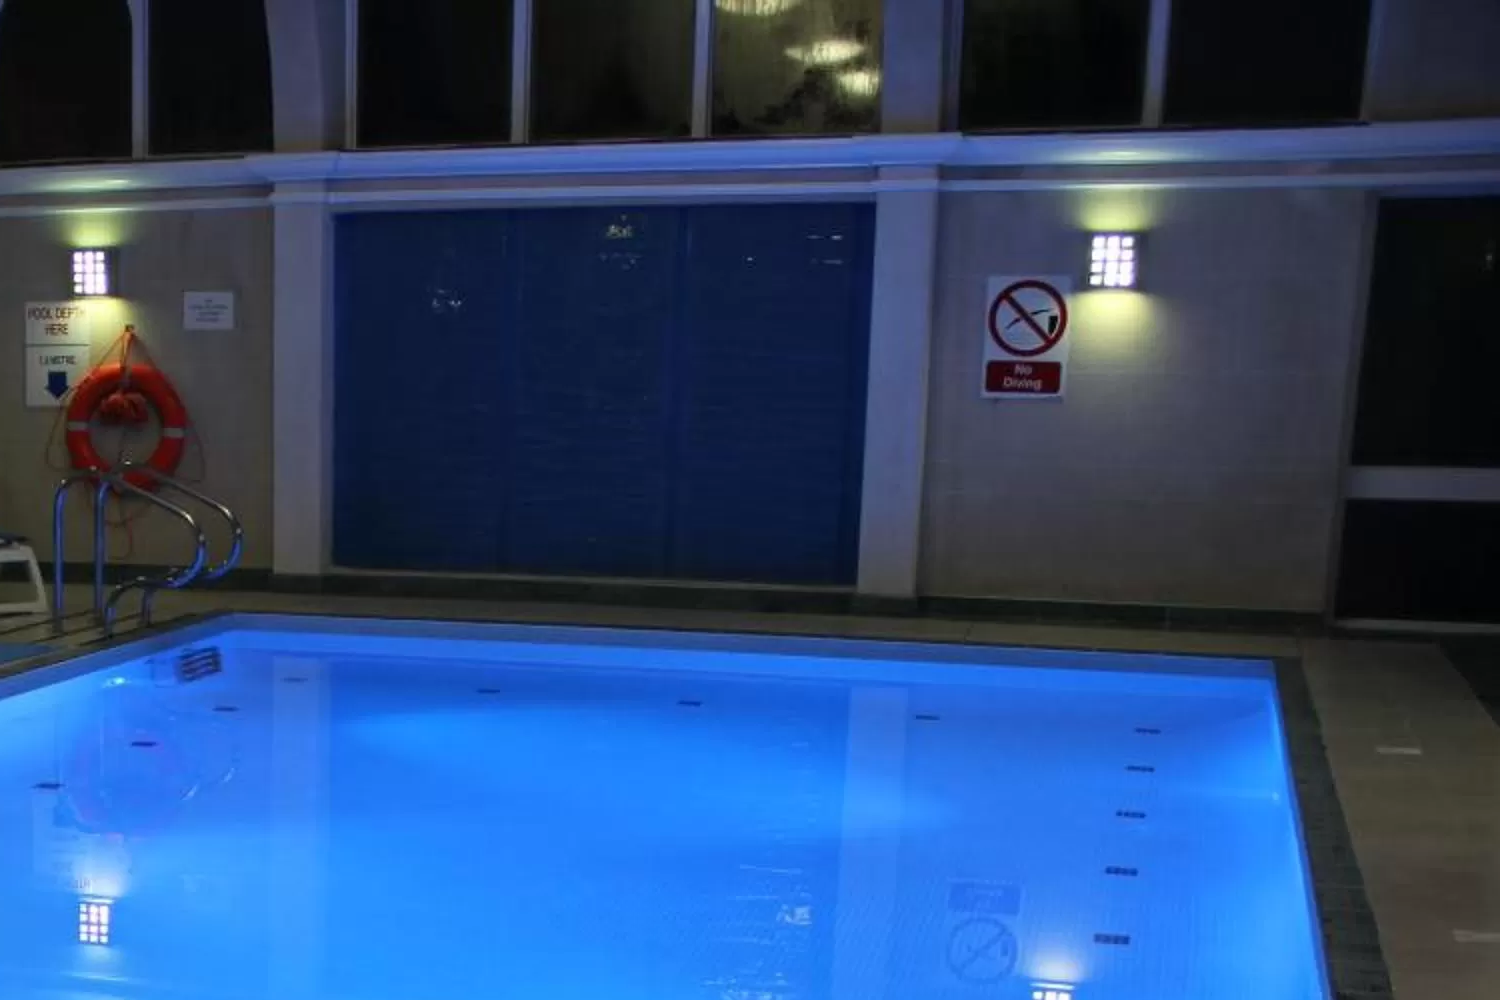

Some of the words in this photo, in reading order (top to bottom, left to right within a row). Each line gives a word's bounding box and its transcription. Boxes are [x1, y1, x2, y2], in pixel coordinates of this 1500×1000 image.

[28, 306, 53, 320] POOL
[44, 323, 68, 335] HERE
[1014, 363, 1033, 376] No
[1003, 376, 1042, 391] Diving
